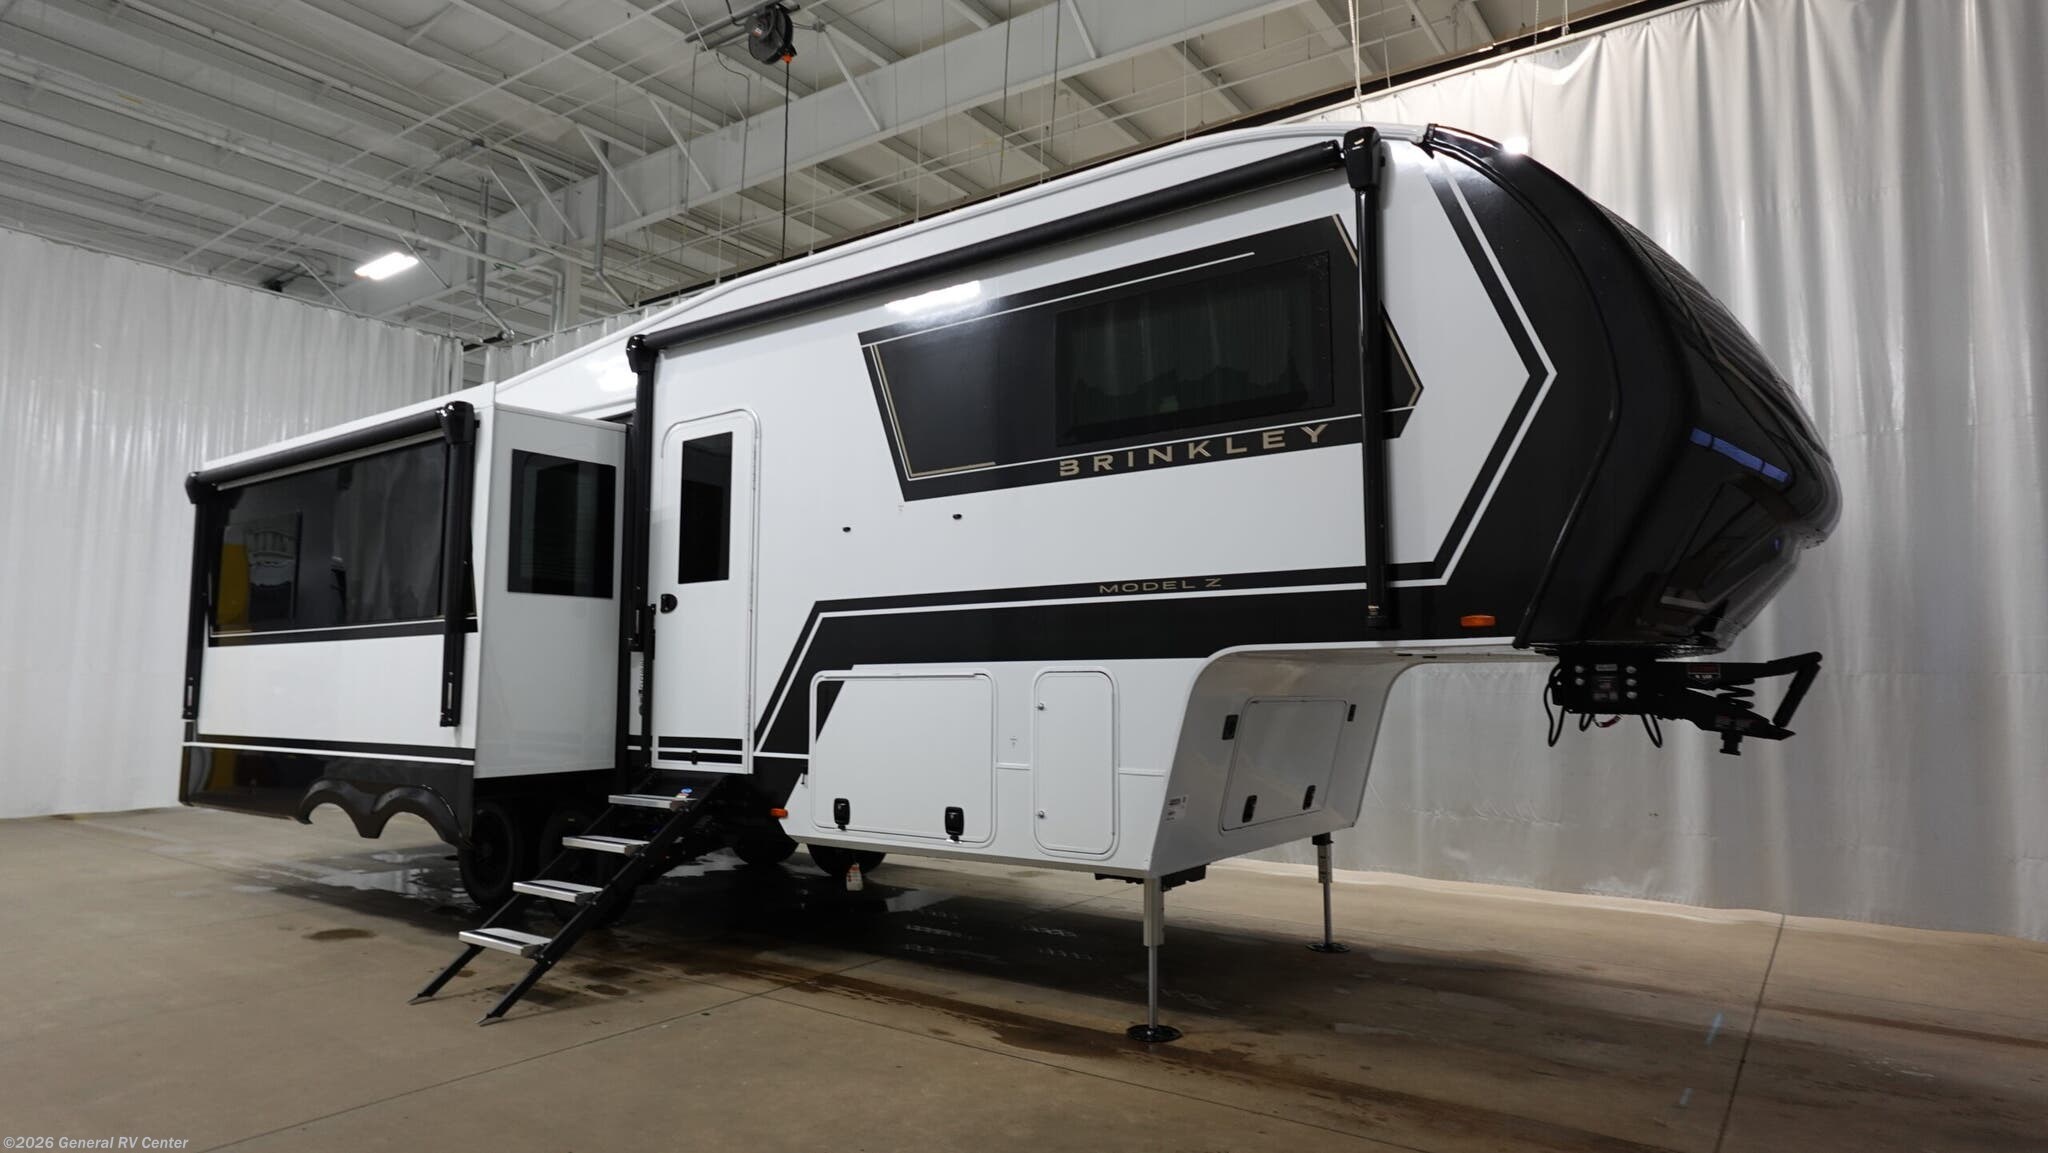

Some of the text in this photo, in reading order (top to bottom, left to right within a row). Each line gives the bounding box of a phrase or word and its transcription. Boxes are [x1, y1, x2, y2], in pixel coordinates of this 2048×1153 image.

[1059, 424, 1328, 477] BRINKLEY
[1099, 578, 1222, 594] MODEL Z
